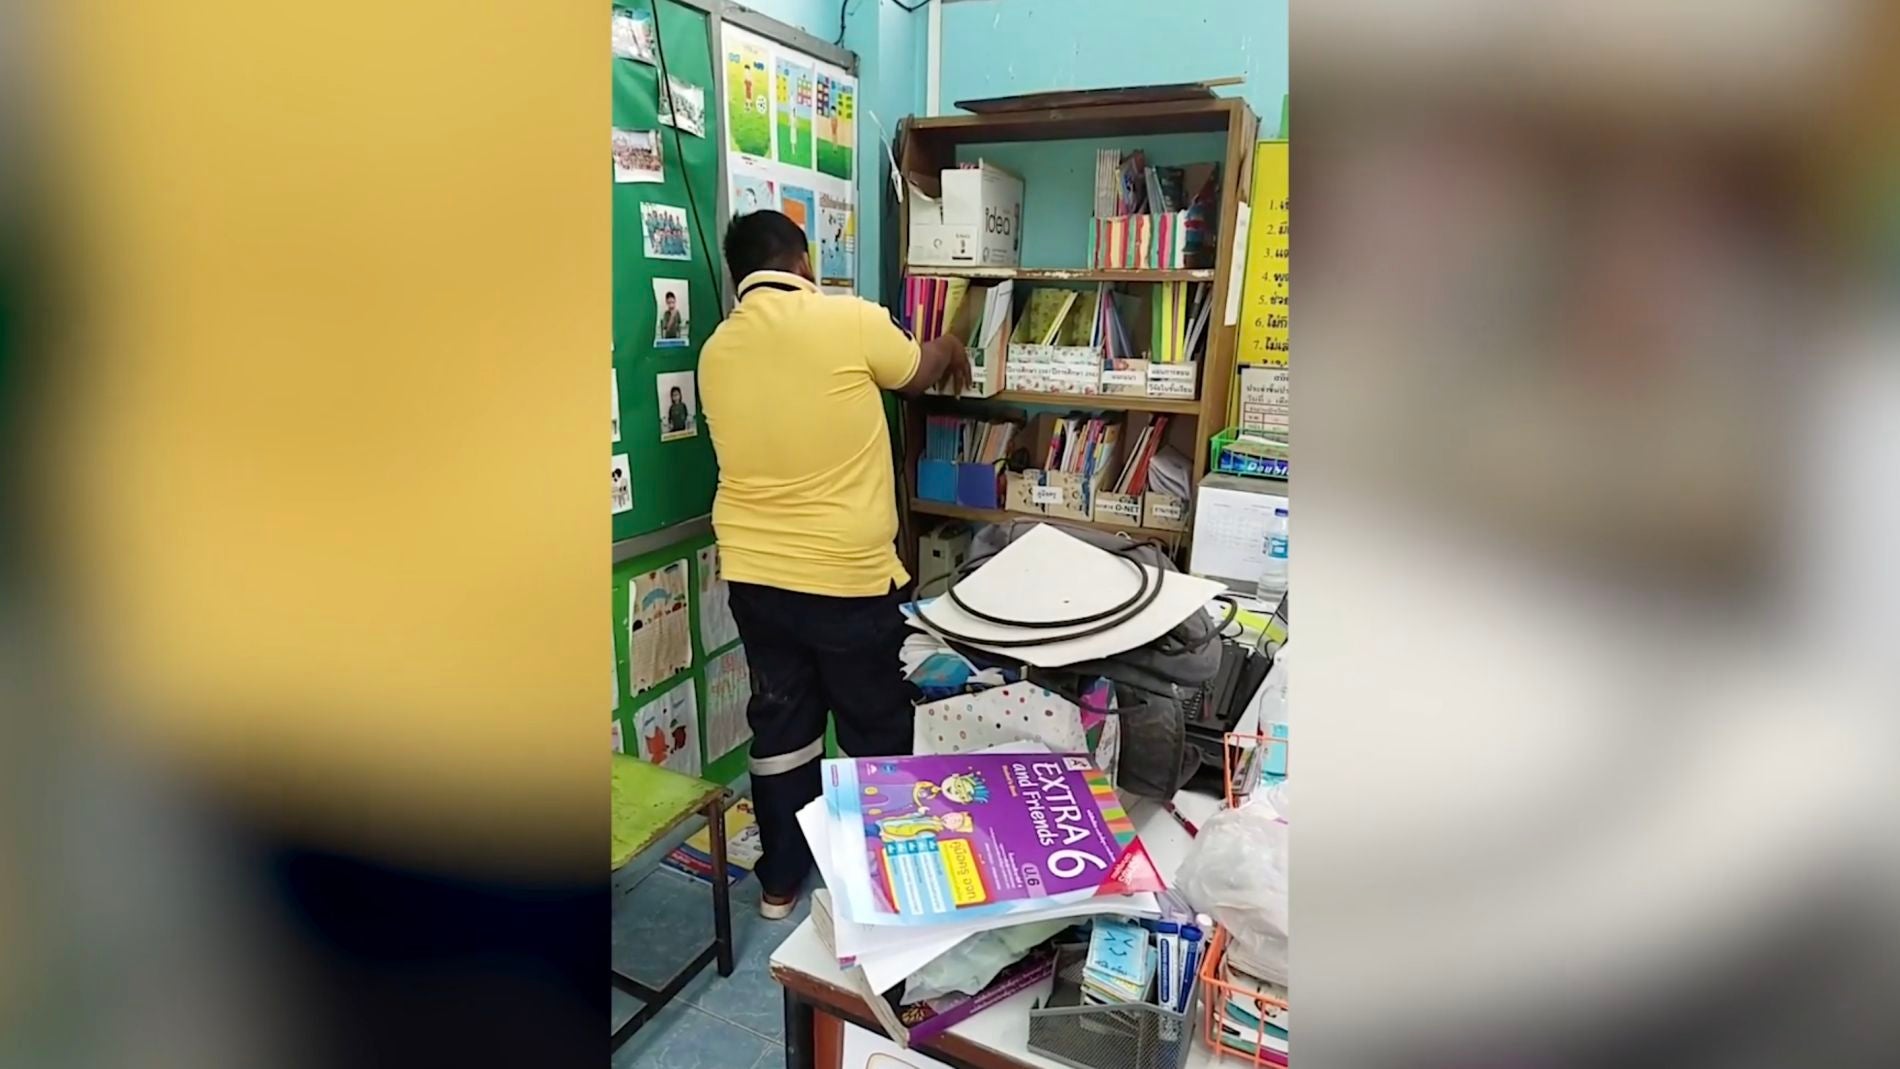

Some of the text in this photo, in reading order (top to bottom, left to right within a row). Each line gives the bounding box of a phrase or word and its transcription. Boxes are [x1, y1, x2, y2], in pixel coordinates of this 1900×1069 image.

[1269, 199, 1278, 211] 1.
[985, 206, 1011, 236] idea
[1265, 223, 1276, 235] 2.
[1264, 247, 1274, 259] 3.
[1261, 271, 1272, 283] 4.
[1258, 294, 1268, 305] 5.
[1255, 317, 1265, 329] 6.
[1253, 339, 1263, 351] 7.
[1115, 503, 1140, 513] O-NET
[1012, 763, 1059, 846] and Friends
[1032, 762, 1091, 846] EXTRA
[1047, 849, 1108, 879] 6
[1024, 866, 1040, 886] ป.6
